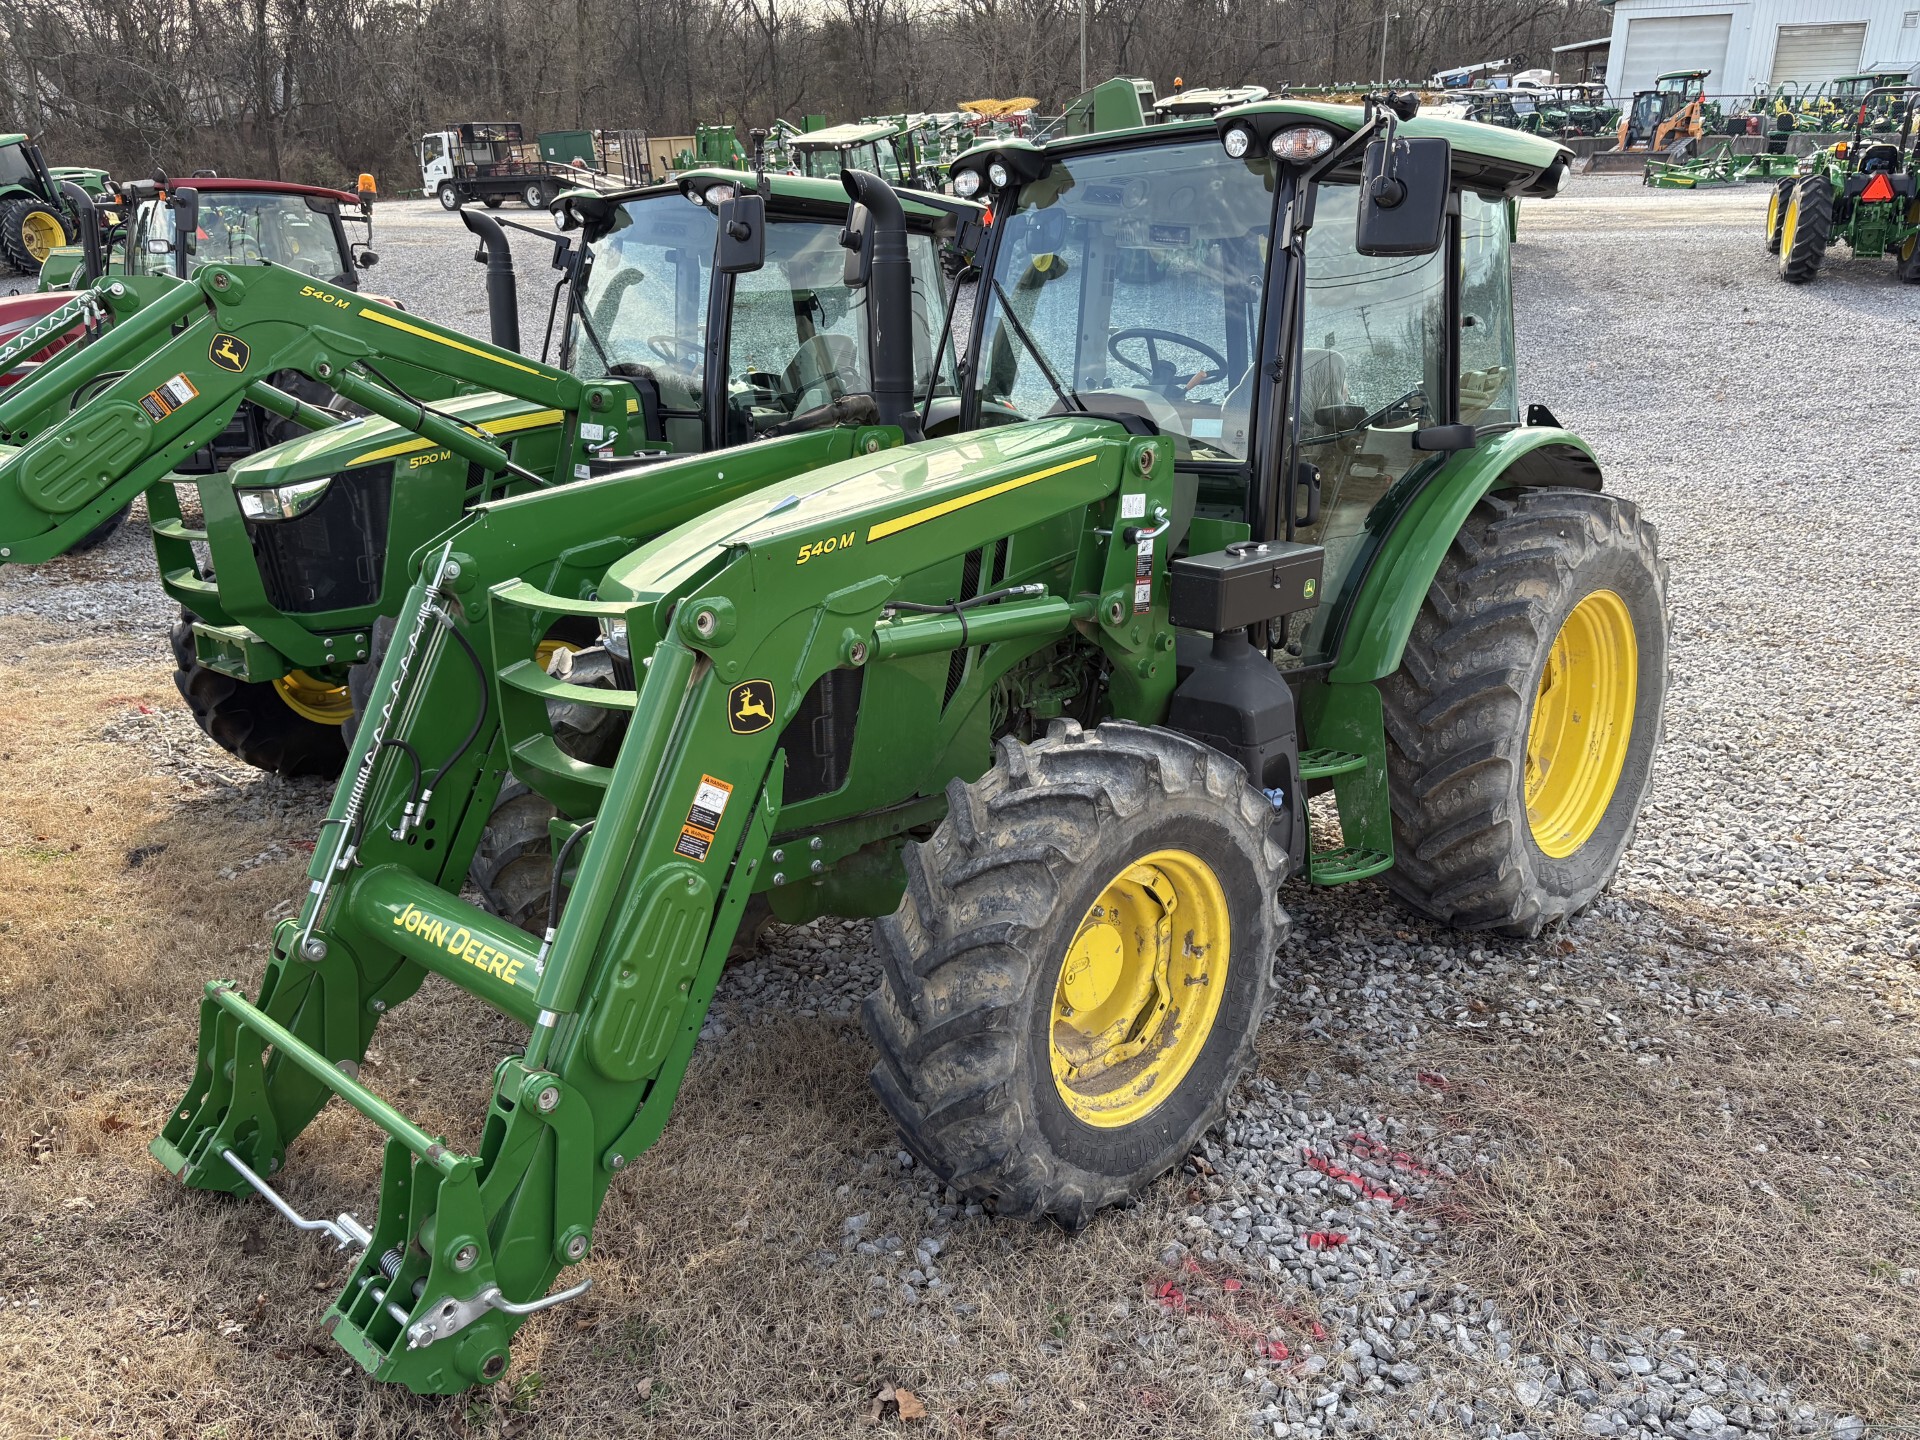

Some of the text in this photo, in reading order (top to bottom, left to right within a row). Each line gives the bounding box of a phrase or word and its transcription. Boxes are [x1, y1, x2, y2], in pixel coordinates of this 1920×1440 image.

[299, 285, 351, 310] 540 M
[409, 450, 451, 469] 5120 M
[796, 530, 856, 565] 540 M
[393, 902, 525, 986] JOHN DEERE
